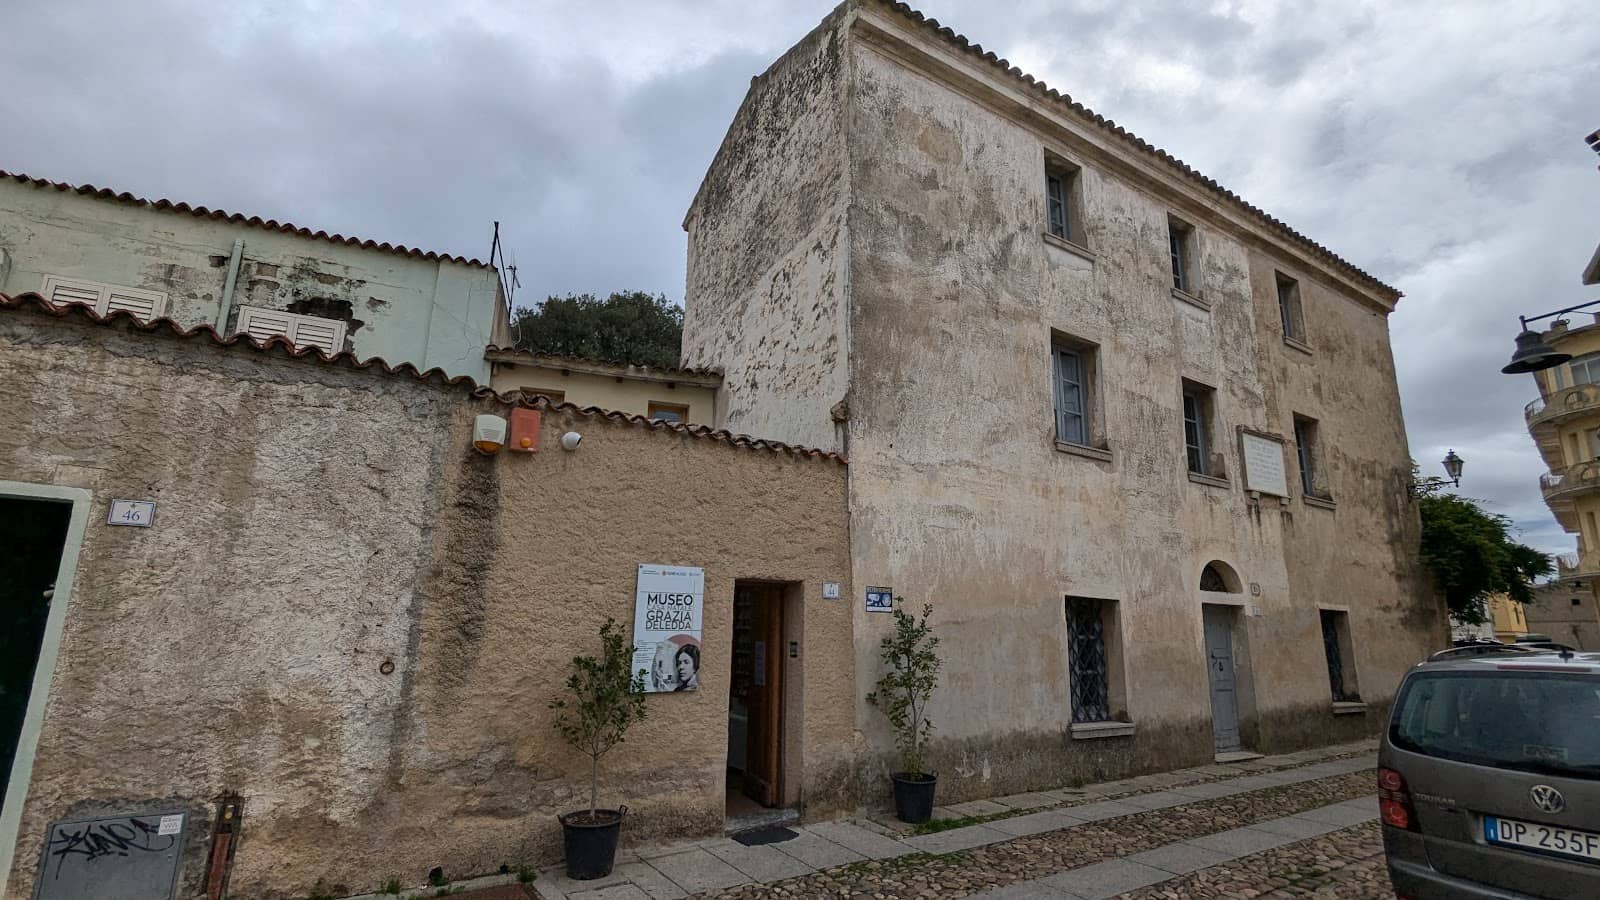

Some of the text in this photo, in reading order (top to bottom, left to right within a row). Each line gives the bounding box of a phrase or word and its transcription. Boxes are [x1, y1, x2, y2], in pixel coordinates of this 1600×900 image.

[122, 510, 140, 521] 46
[647, 593, 693, 606] MUSEO
[646, 610, 692, 622] GRAZIA
[645, 620, 691, 630] DELEDDA
[1500, 820, 1527, 842] DP
